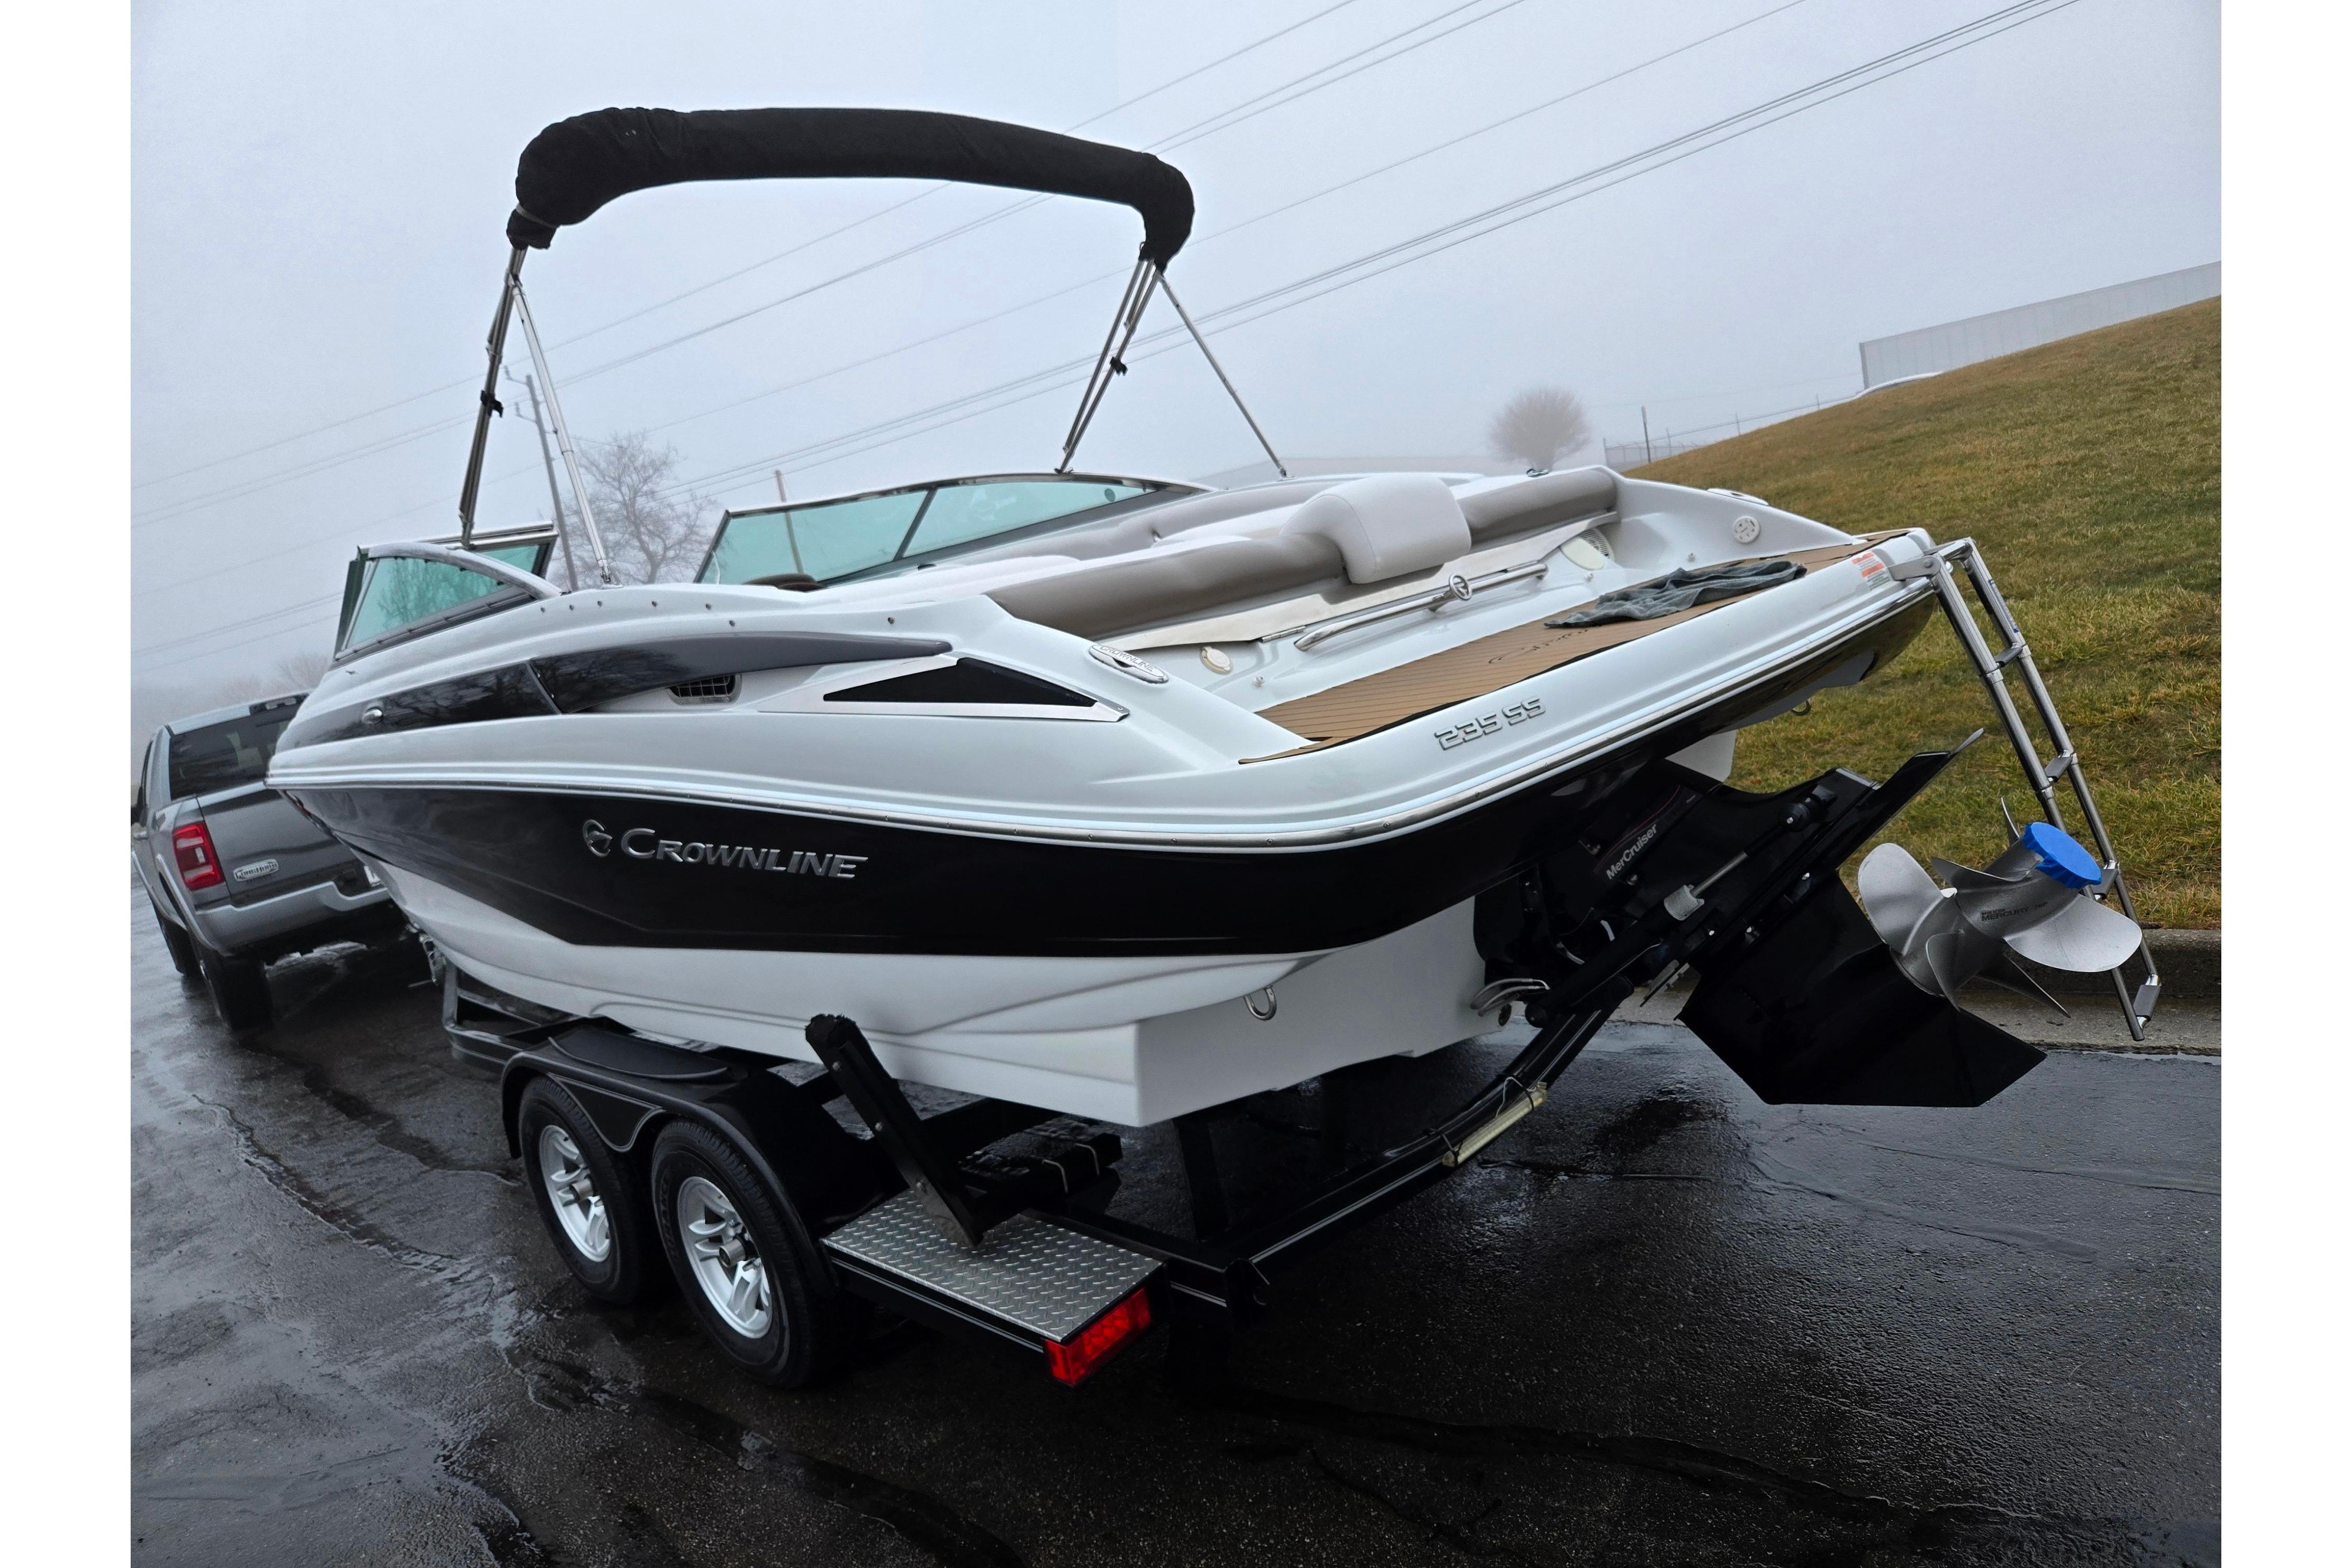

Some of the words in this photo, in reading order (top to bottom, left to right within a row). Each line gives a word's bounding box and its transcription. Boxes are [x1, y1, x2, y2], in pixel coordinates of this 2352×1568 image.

[1100, 645, 1154, 672] CROWNLINE
[1434, 712, 1503, 751] 235
[1502, 695, 1546, 725] SS
[1606, 824, 1657, 880] MerCruiser
[1981, 906, 2029, 921] MERCURY
